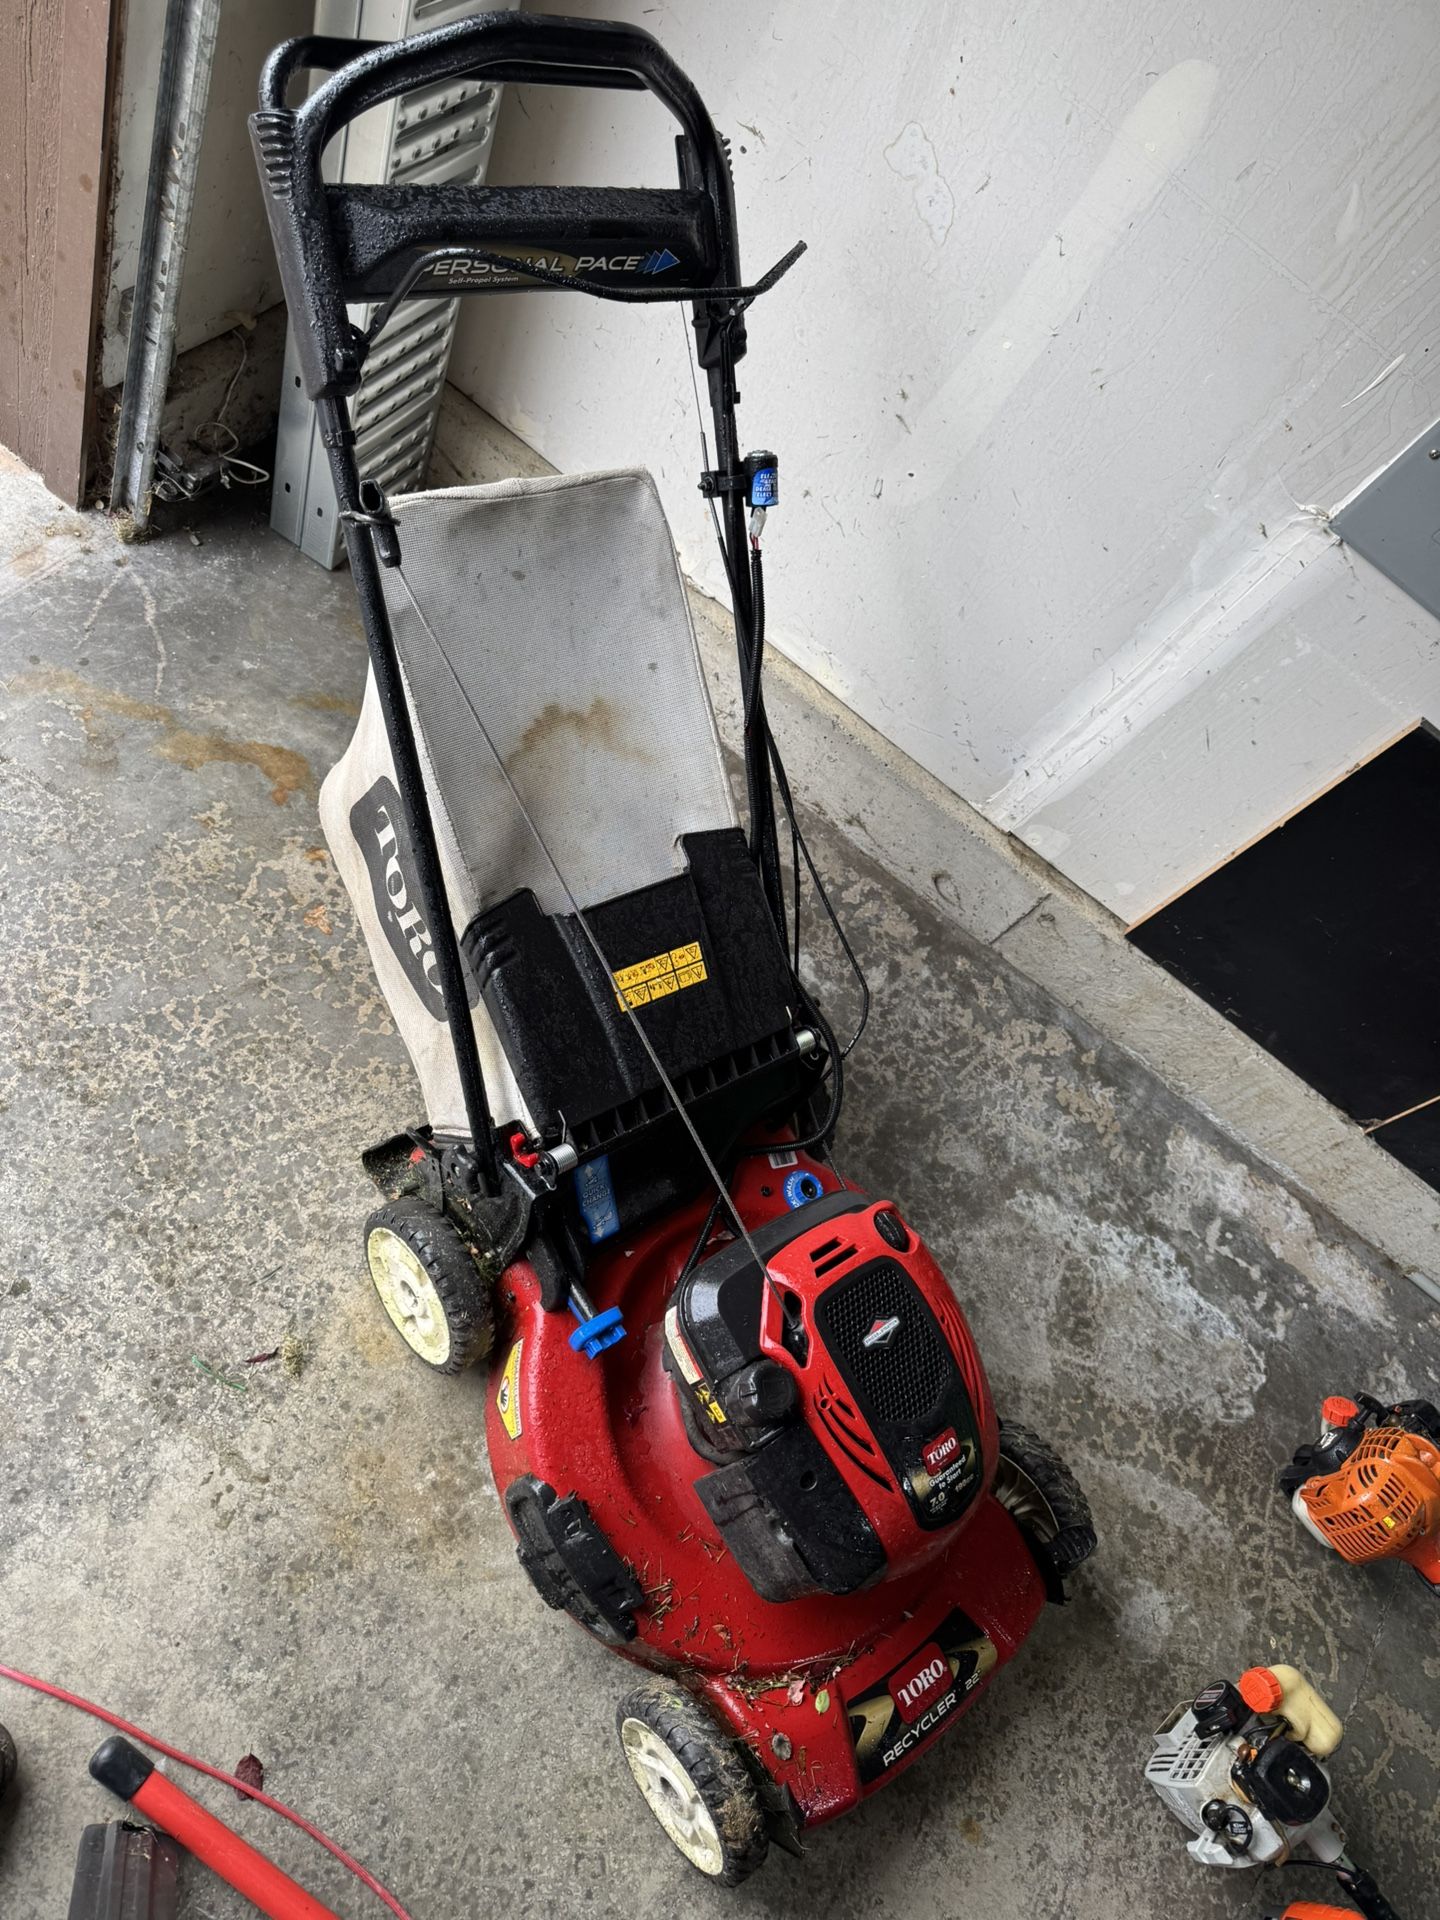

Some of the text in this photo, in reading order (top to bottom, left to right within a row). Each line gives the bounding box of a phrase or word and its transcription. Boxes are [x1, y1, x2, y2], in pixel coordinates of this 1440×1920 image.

[424, 256, 642, 276] ERSAL PACE
[448, 275, 519, 285] Self-Propel System
[582, 1184, 606, 1198] QUICK
[927, 1437, 957, 1466] TORO
[929, 1454, 967, 1487] Guaranteed
[938, 1468, 962, 1490] to Start
[929, 1491, 946, 1507] 7.0
[897, 1659, 945, 1707] TORO
[882, 1692, 957, 1767] RECYCLER
